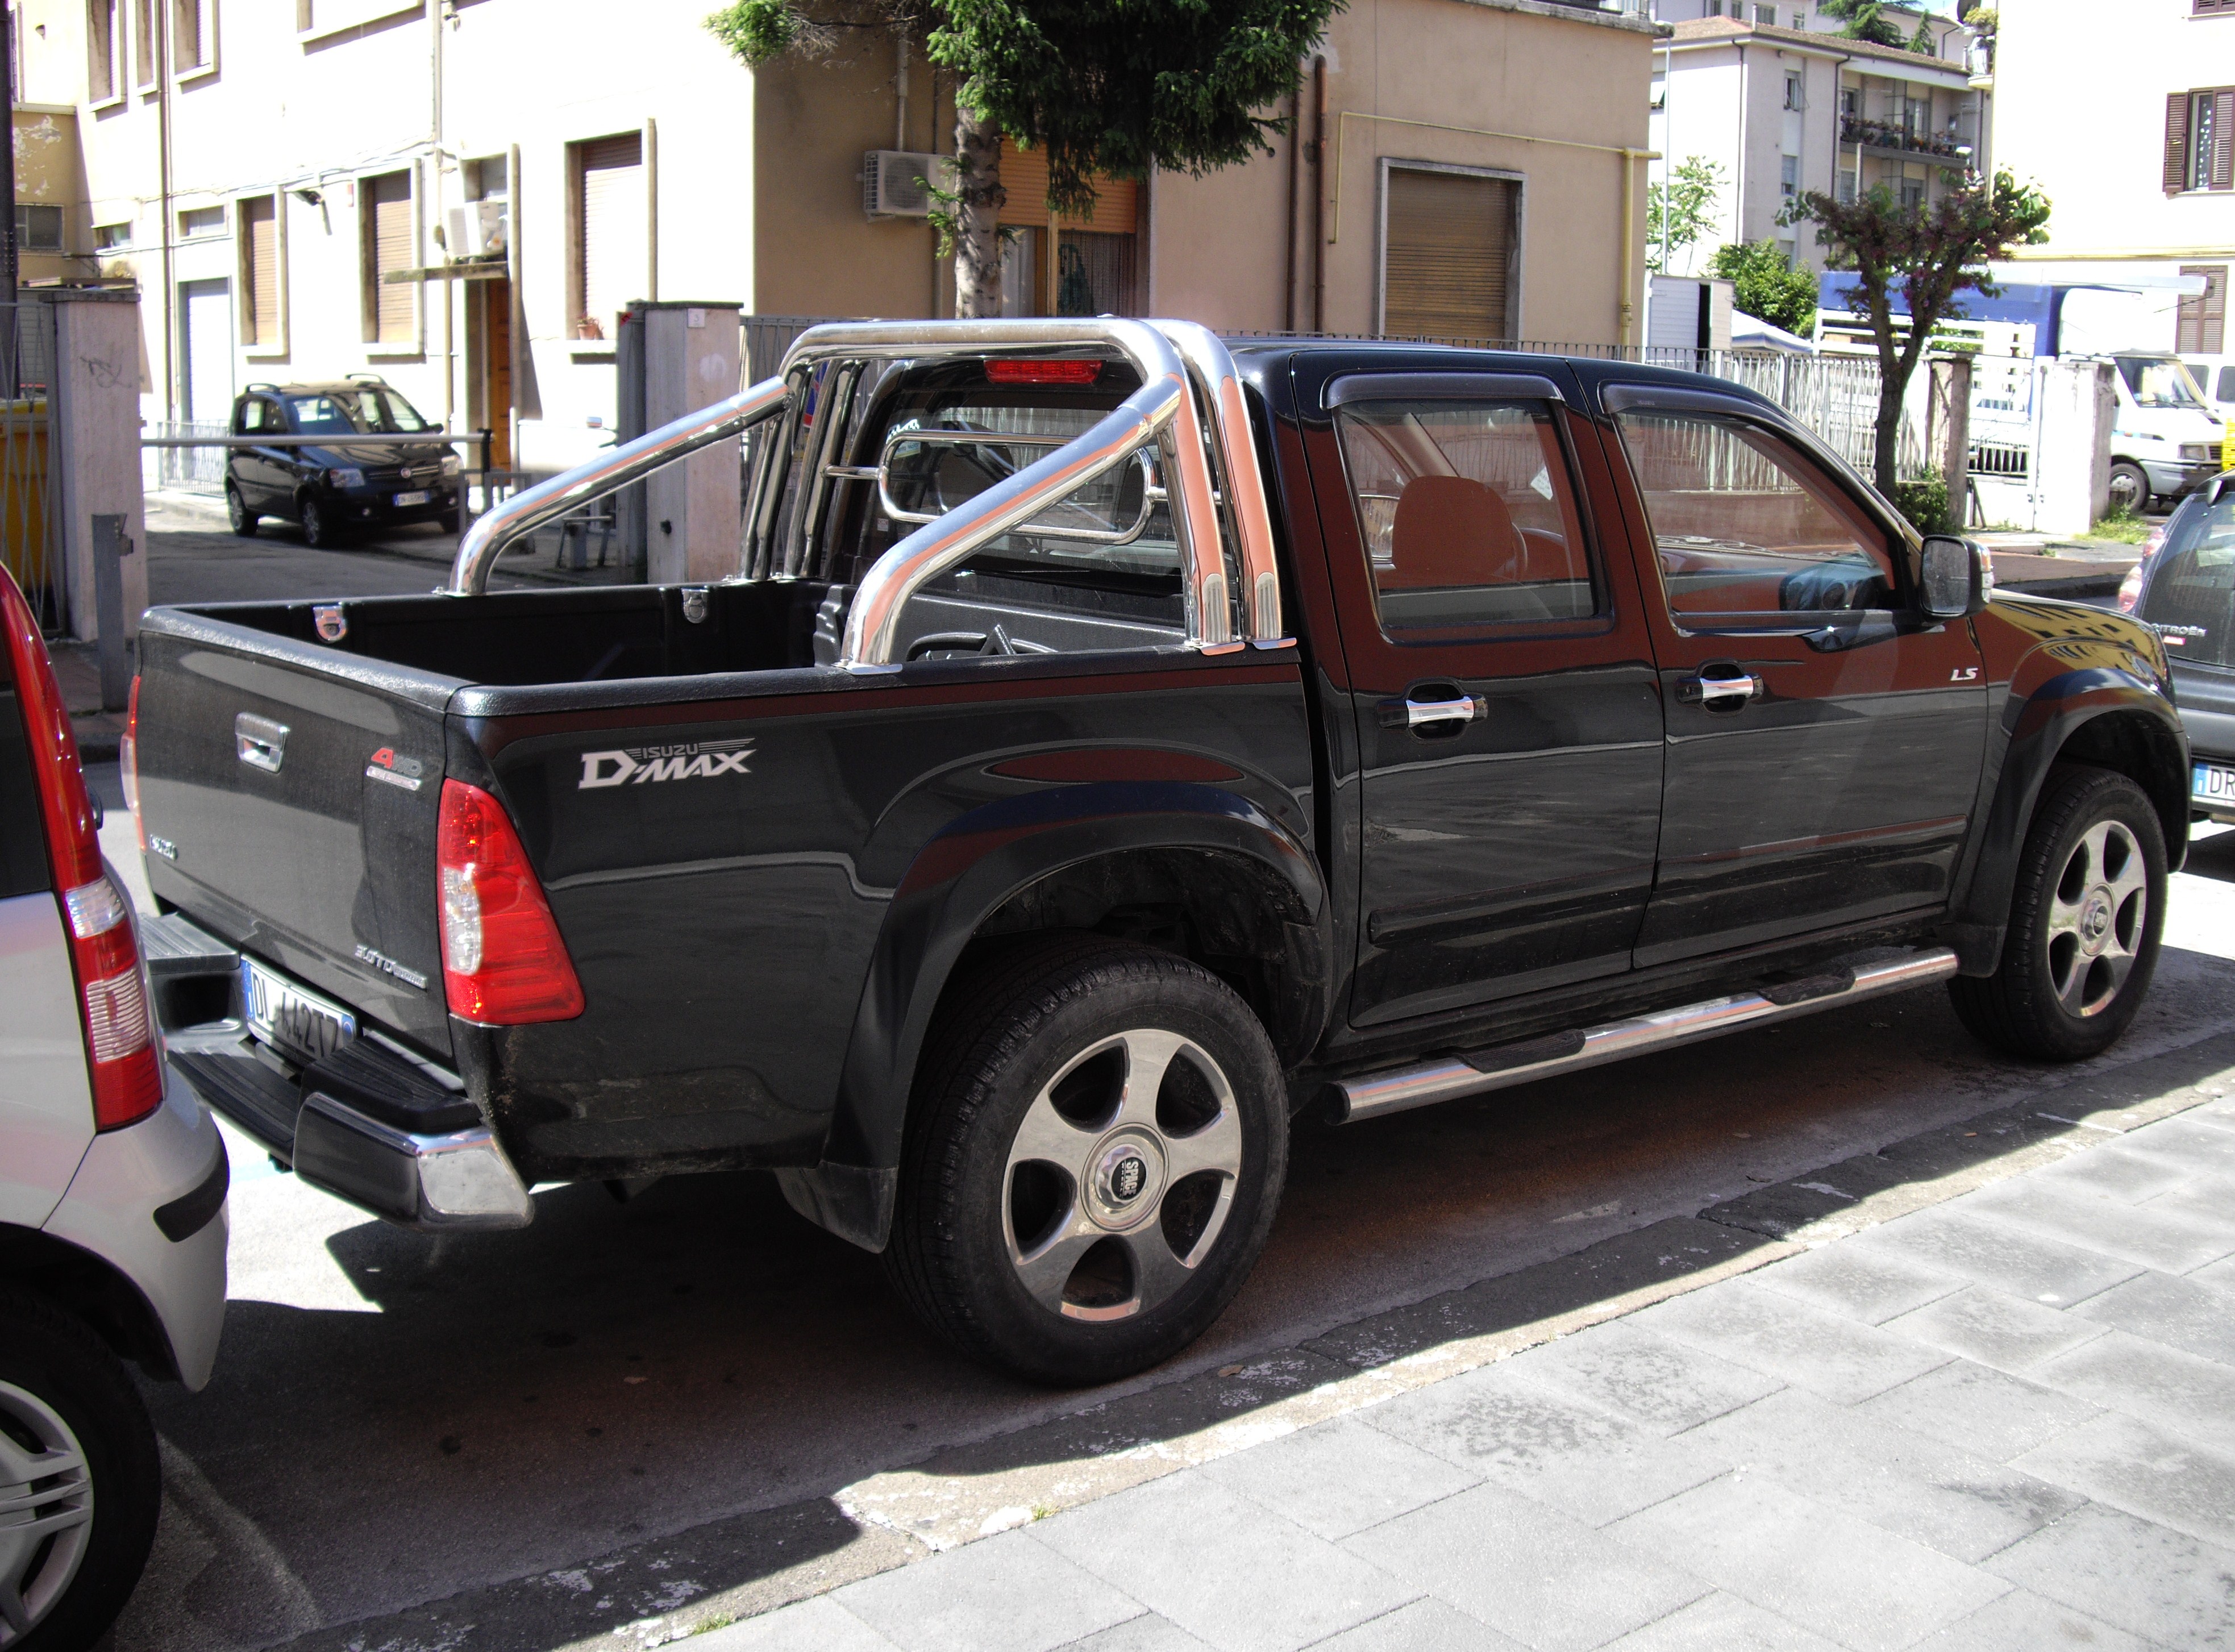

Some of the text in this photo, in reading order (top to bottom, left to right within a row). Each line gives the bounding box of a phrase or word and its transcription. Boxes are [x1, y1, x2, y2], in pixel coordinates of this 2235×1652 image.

[1950, 668, 1978, 681] LS
[642, 743, 698, 759] ISUZU
[578, 749, 757, 789] D-MAX
[2210, 768, 2235, 796] DR
[1125, 1161, 1139, 1196] SPACE
